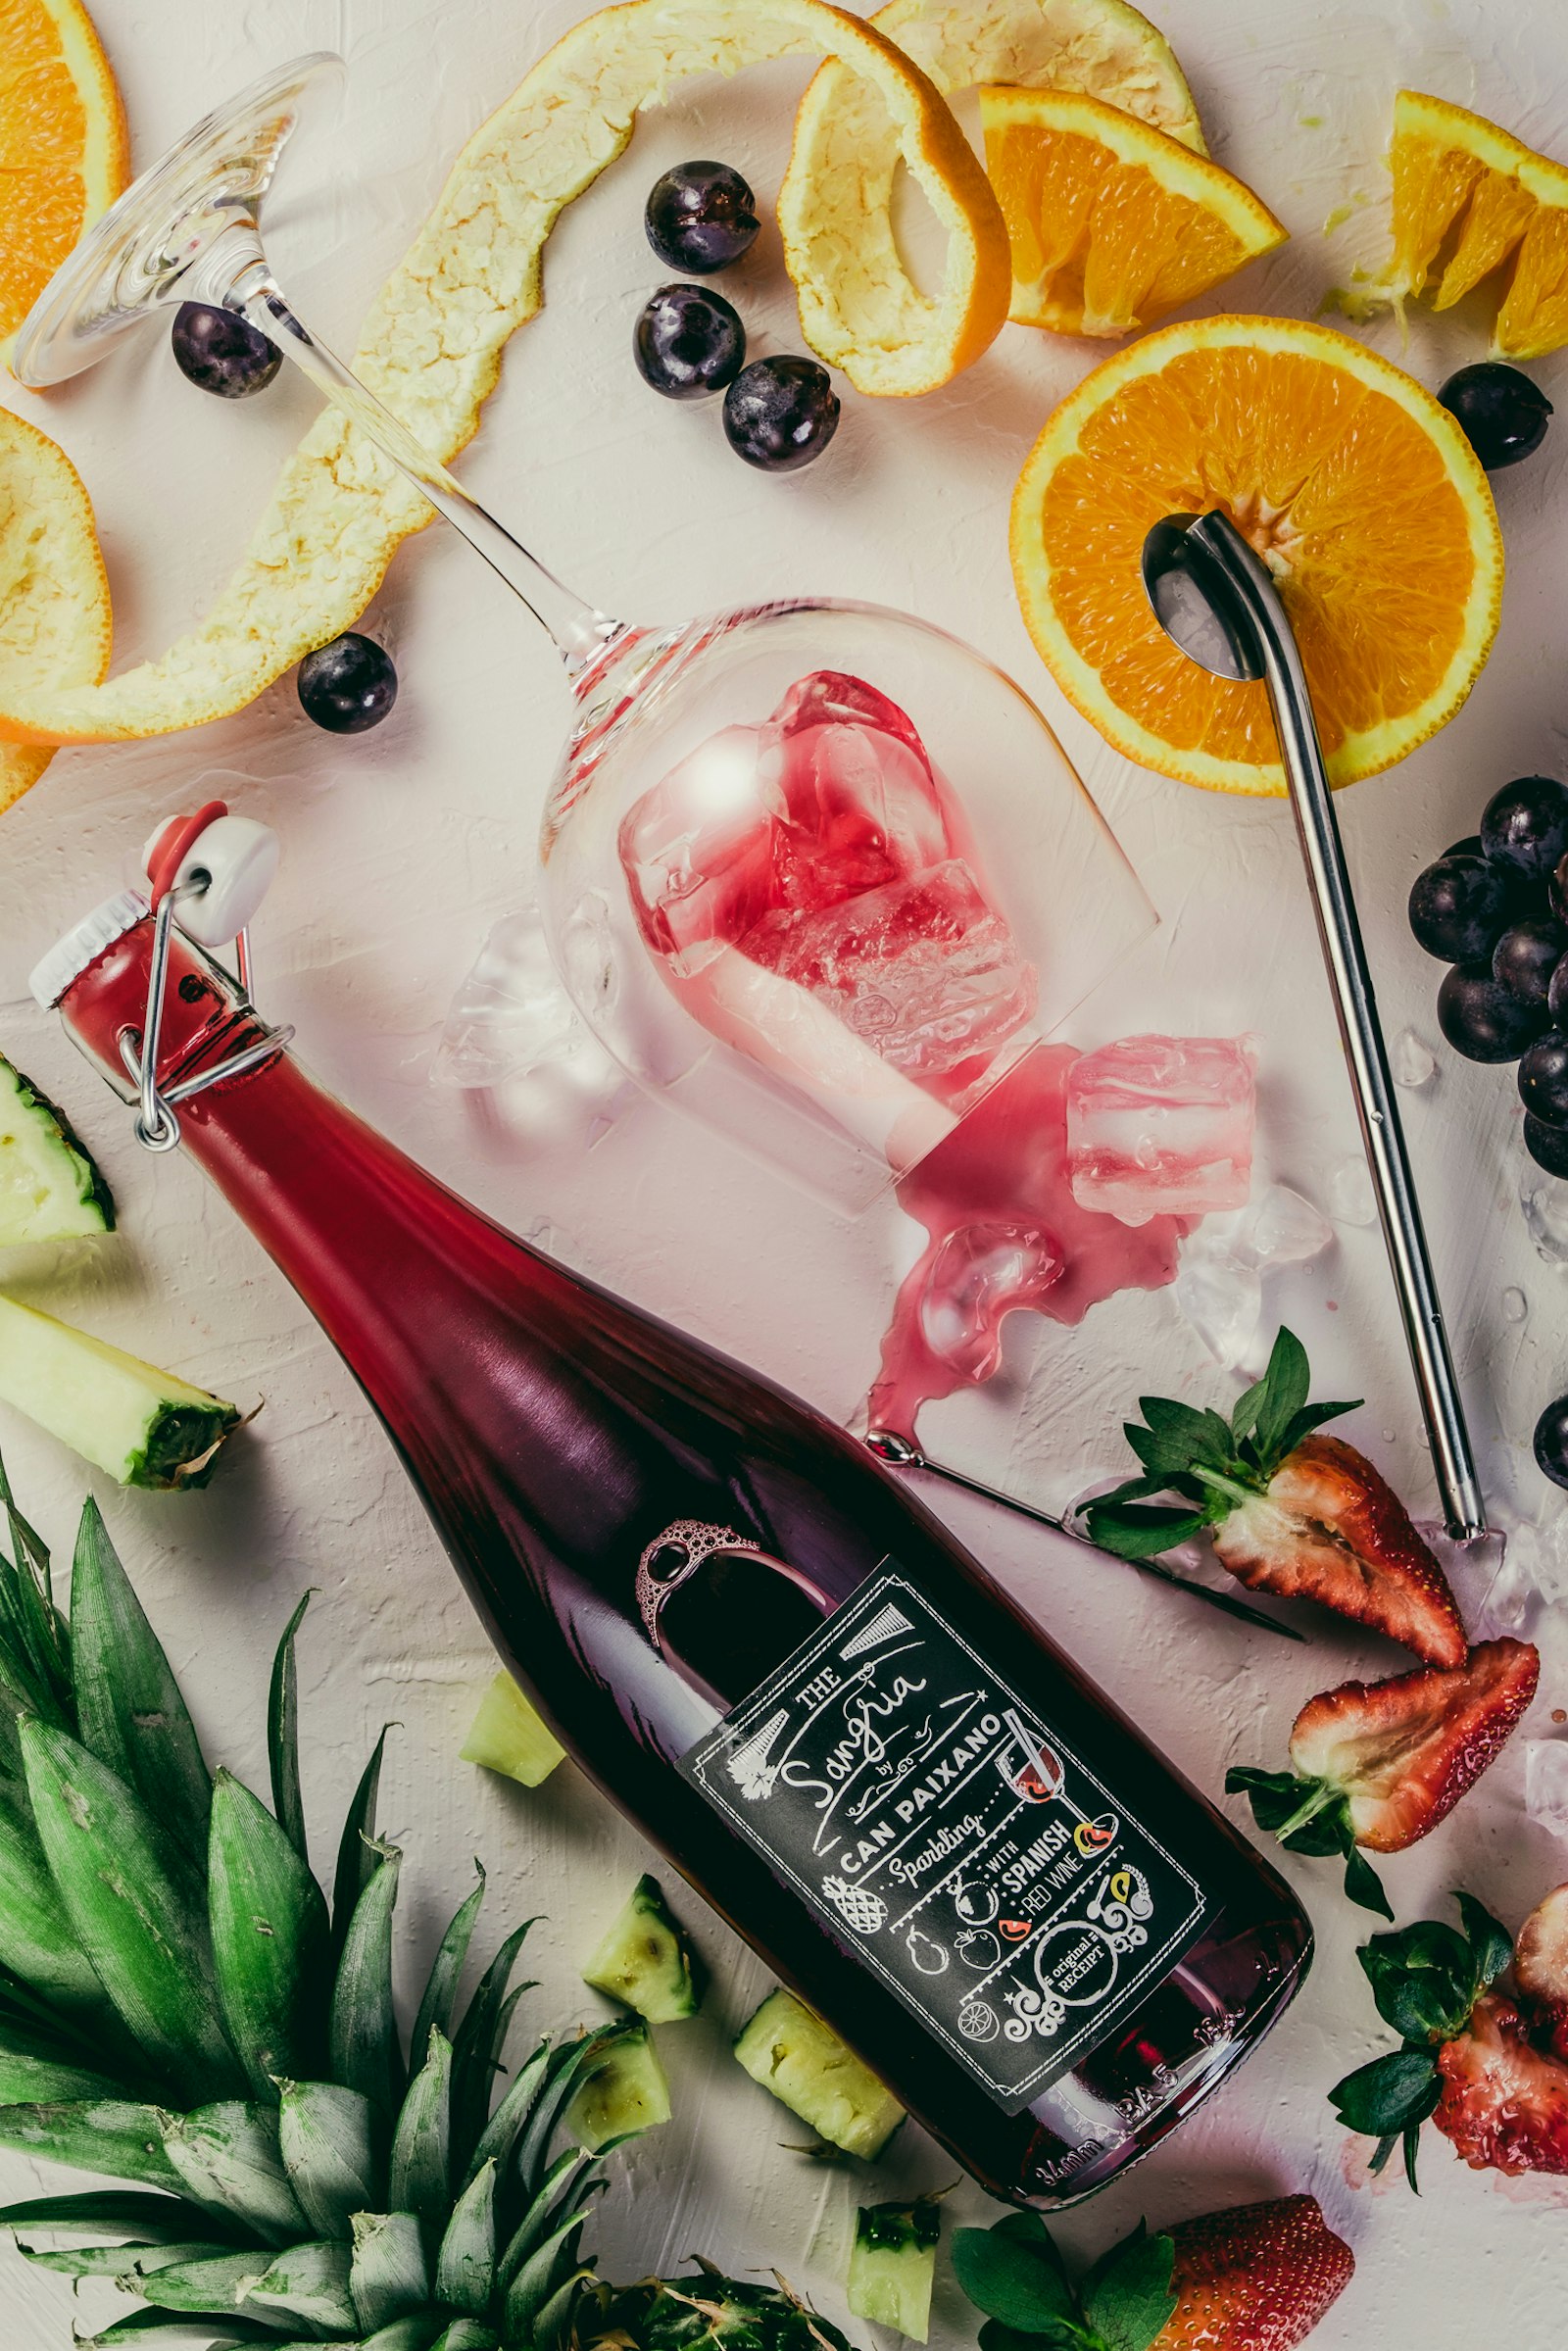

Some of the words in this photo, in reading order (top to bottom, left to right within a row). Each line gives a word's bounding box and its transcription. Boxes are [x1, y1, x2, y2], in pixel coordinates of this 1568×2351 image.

[795, 1667, 842, 1711] THE
[781, 1675, 927, 1808] Sangria
[875, 1761, 894, 1777] by
[840, 1821, 897, 1873] CAN
[895, 1714, 1001, 1823] PAIXANO
[889, 1815, 987, 1888] Sparkling
[986, 1840, 1020, 1874] WITH
[1002, 1819, 1072, 1893] SPANISH
[1021, 1885, 1053, 1915] RED
[1045, 1851, 1084, 1889] WINE
[1052, 1938, 1092, 1979] original
[1057, 1945, 1105, 1993] RECEIPT
